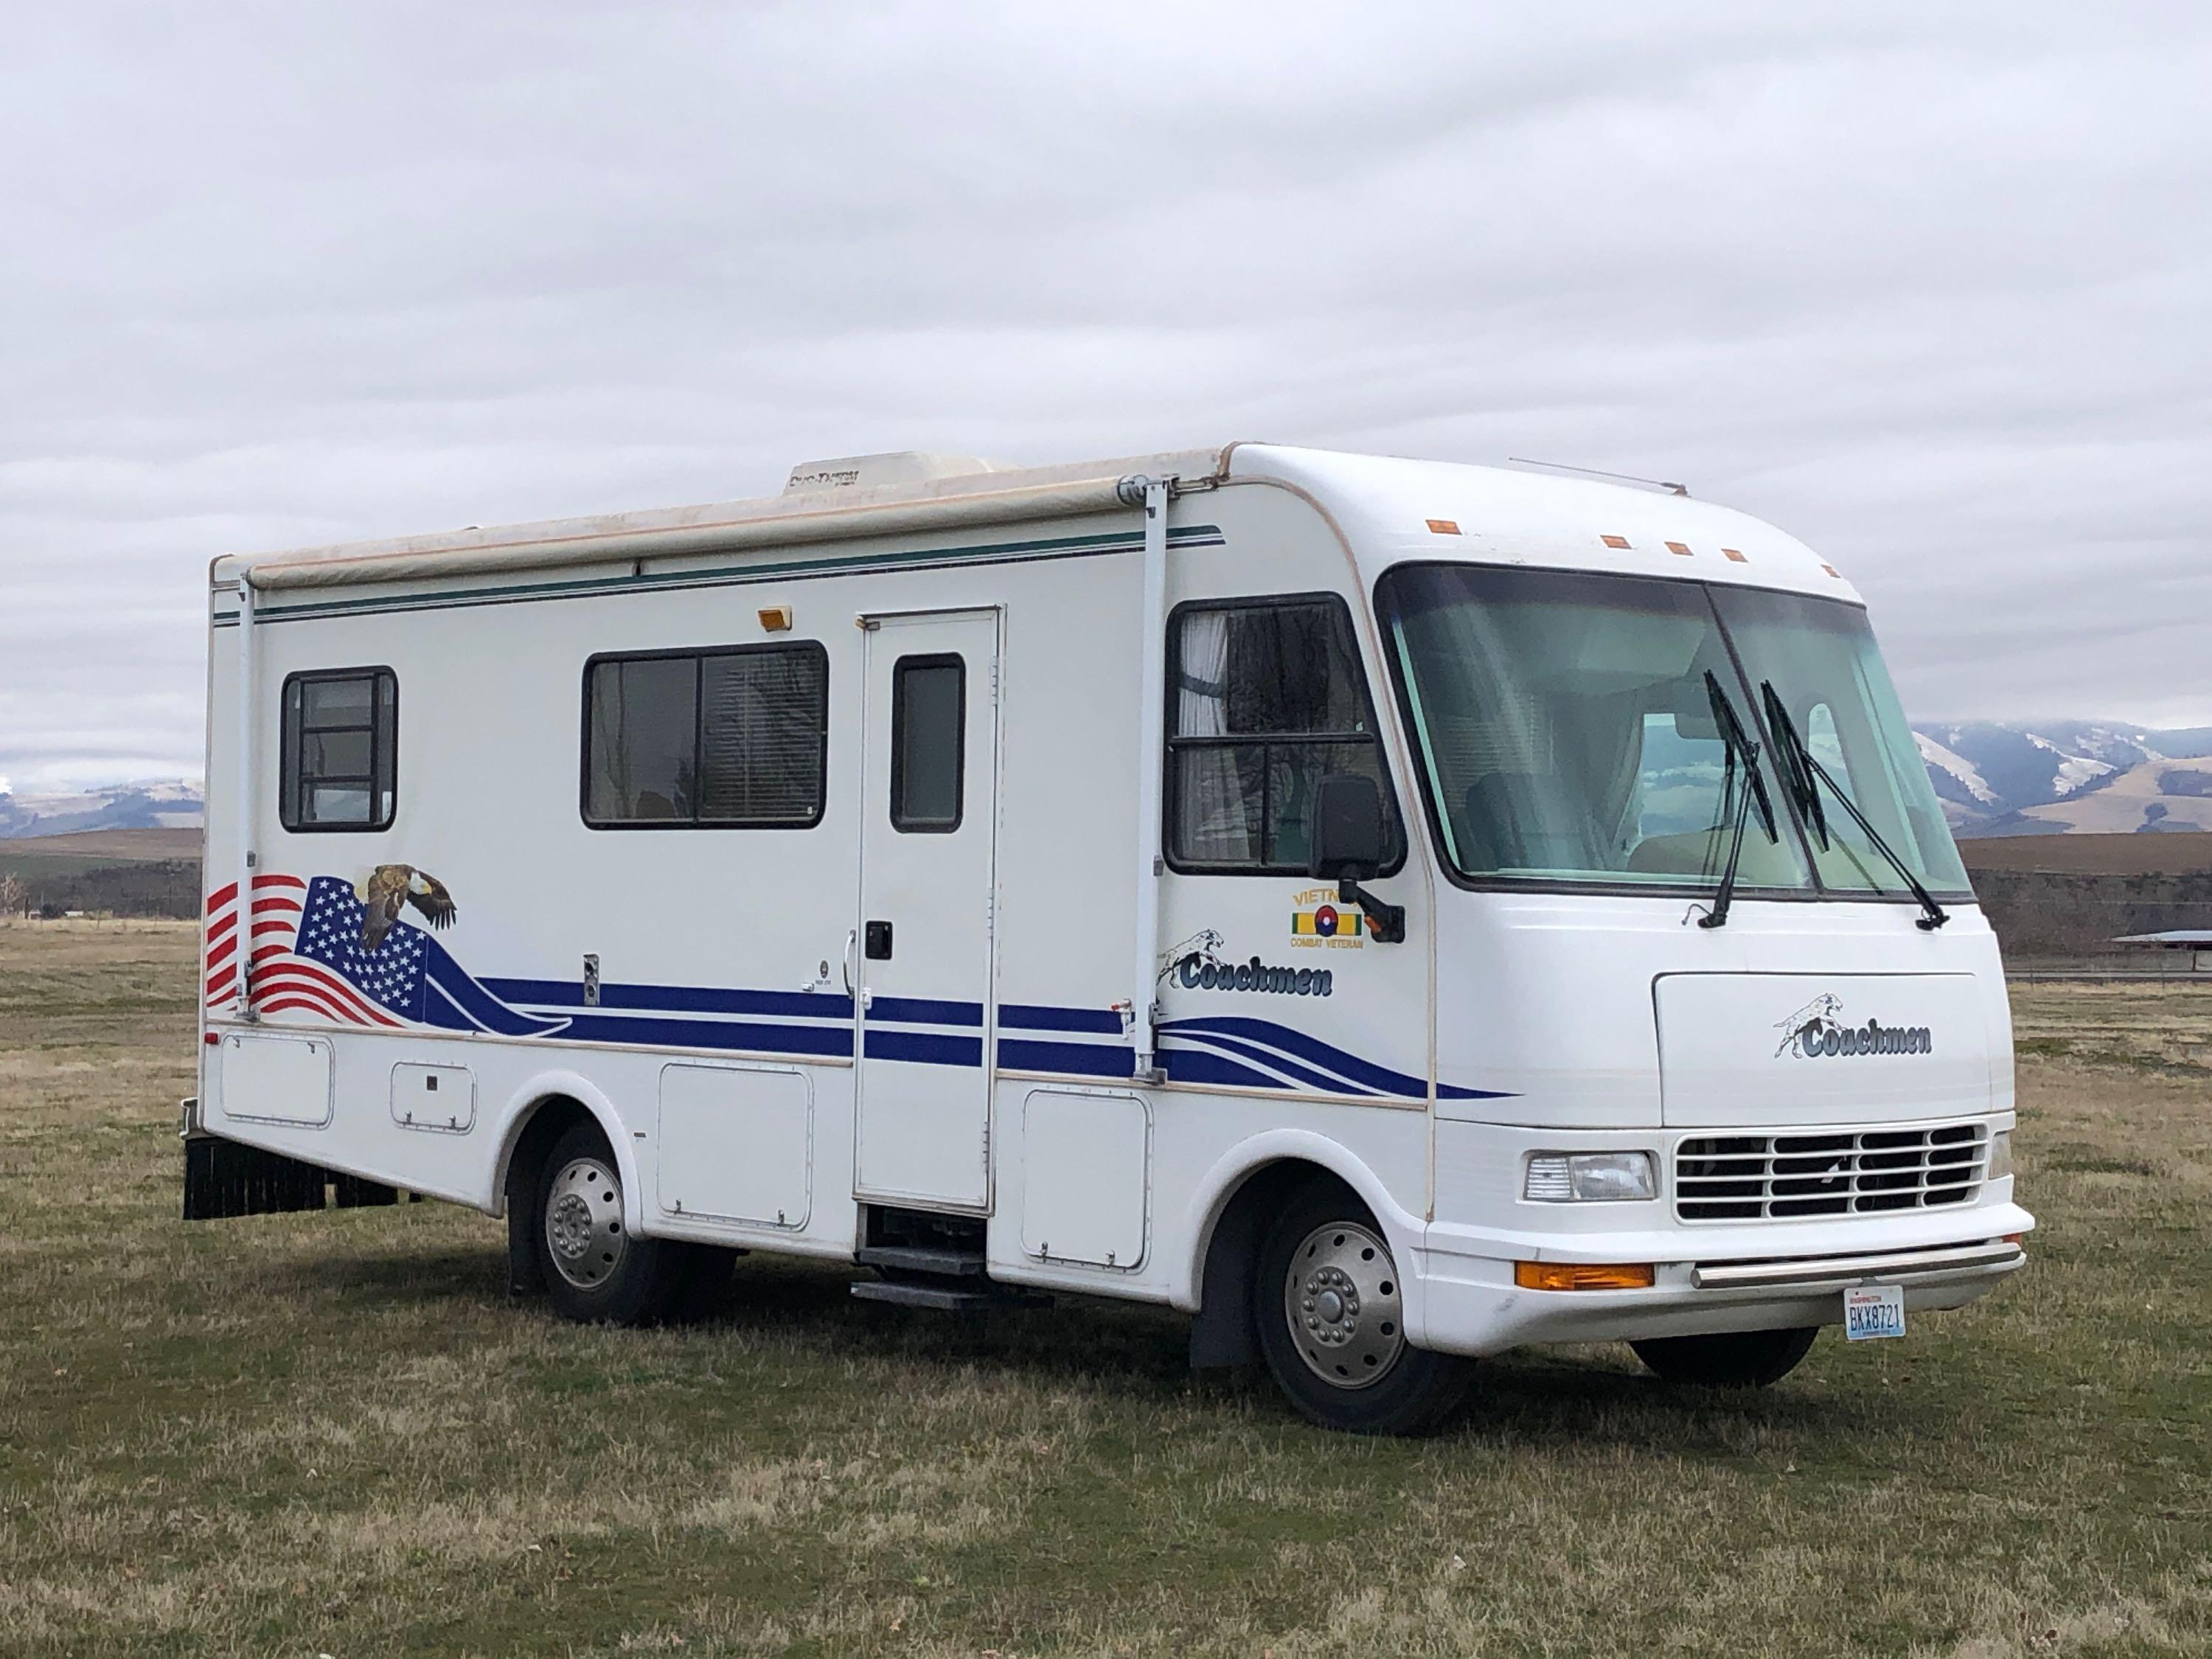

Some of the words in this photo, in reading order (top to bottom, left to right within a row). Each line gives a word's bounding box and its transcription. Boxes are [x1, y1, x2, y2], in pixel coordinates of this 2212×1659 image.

[1293, 888, 1360, 908] VIETN
[1290, 938, 1322, 948] COMBAT
[1326, 939, 1363, 949] VETERAN
[1180, 952, 1333, 997] Coachmen
[1802, 1018, 1932, 1057] Coachmen
[1849, 1304, 1899, 1332] BKX8721
